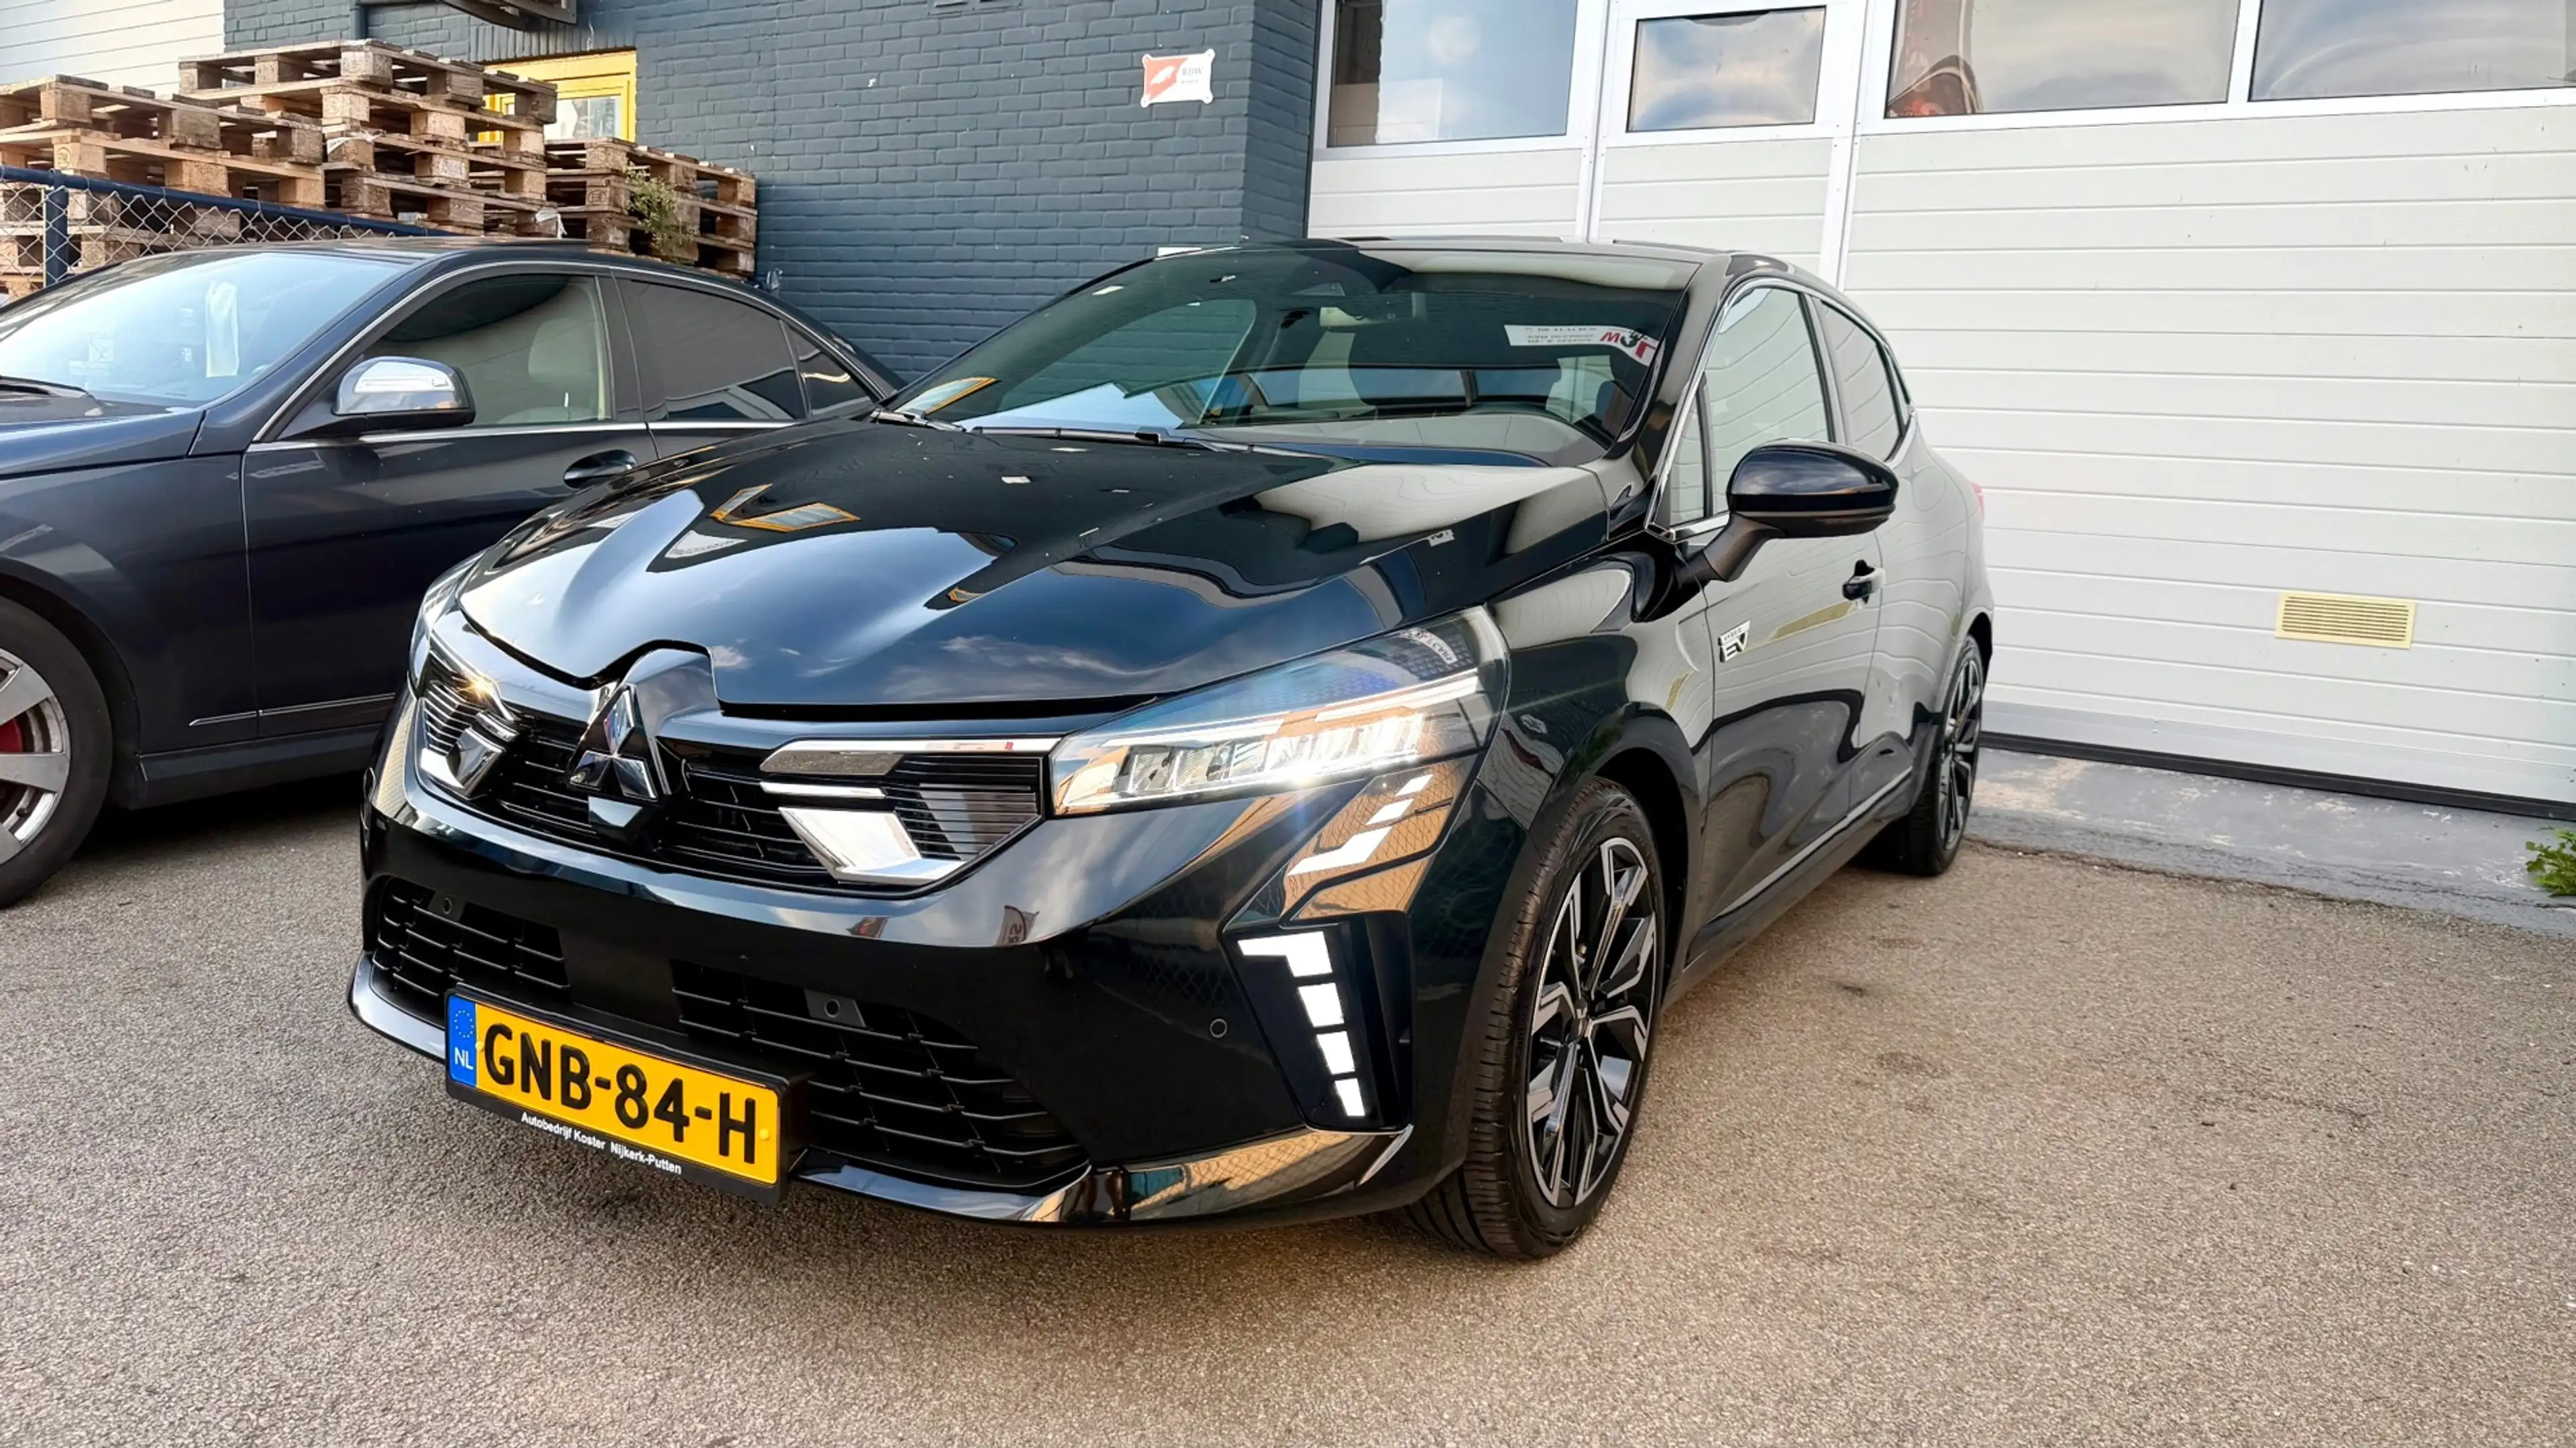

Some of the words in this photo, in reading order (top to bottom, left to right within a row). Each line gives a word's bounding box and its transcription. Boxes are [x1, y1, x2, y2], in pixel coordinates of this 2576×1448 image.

[453, 1047, 474, 1071] NL
[484, 1023, 756, 1165] GNB-84-H
[521, 1111, 572, 1140] Autobedrijf
[573, 1127, 606, 1150] Koster
[610, 1141, 682, 1175] Nijkerk-Putten
